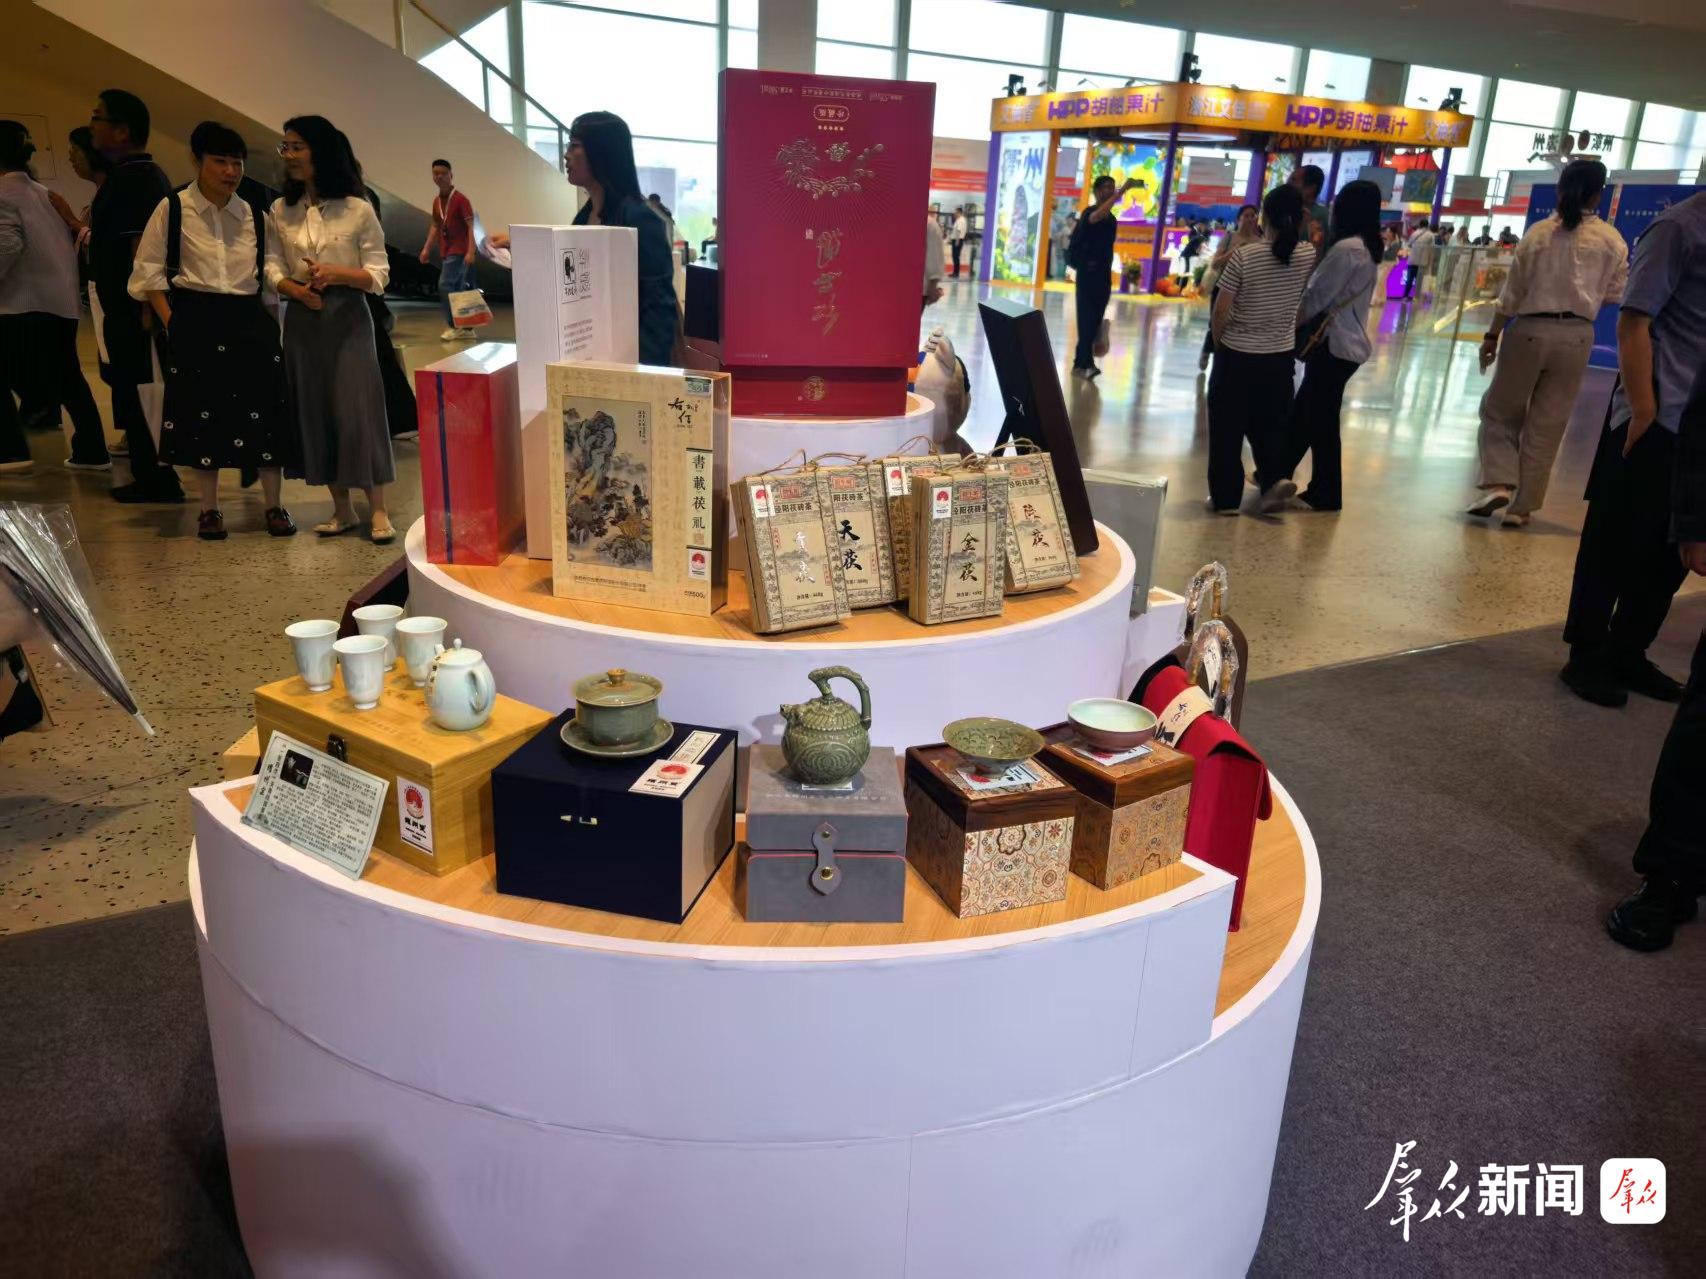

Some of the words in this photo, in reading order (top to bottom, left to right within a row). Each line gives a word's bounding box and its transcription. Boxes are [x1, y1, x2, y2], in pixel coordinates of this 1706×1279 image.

[1286, 104, 1408, 134] HPP胡柚果汁
[833, 492, 864, 502] 阳茯砖茶
